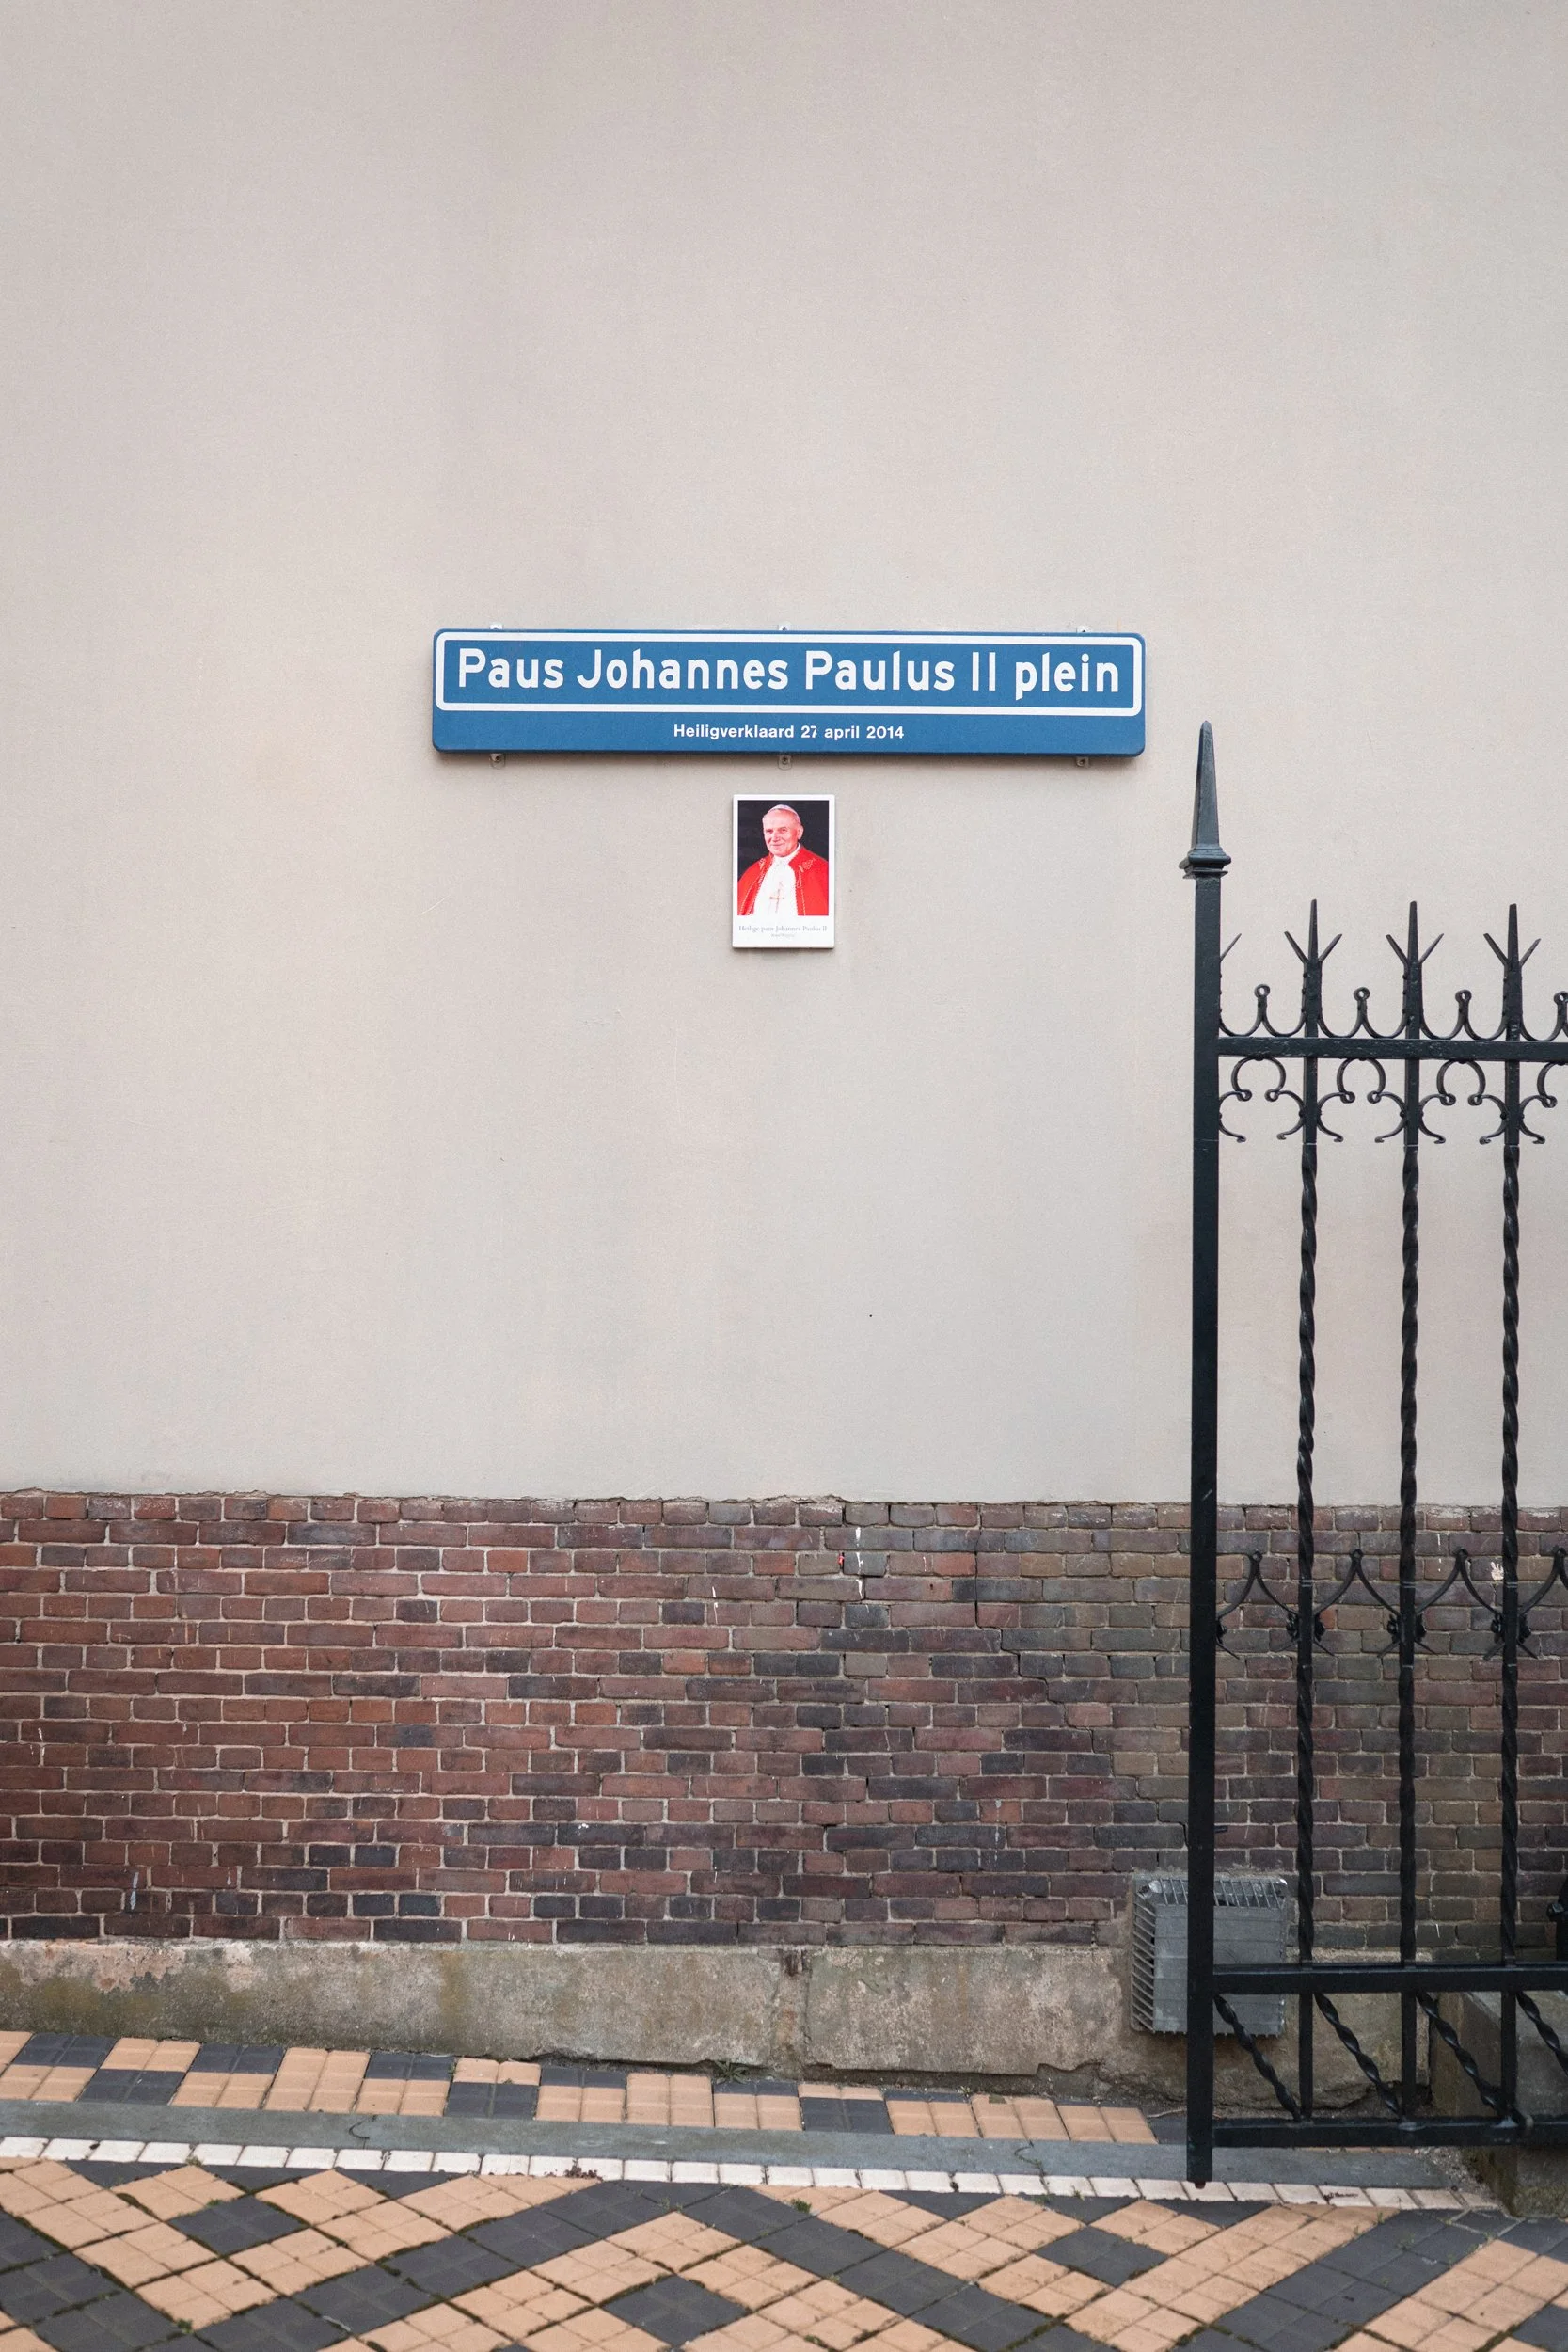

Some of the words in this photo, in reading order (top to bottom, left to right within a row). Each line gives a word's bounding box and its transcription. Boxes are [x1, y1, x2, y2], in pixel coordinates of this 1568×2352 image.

[458, 647, 564, 690] Paus
[577, 647, 789, 691] Johannes
[804, 649, 957, 692] Paulus
[971, 651, 998, 691] II
[1014, 651, 1119, 702] plein
[673, 723, 795, 740] Heiligverklaard
[800, 723, 817, 739] 27
[824, 724, 860, 741] april
[865, 724, 905, 739] 2014
